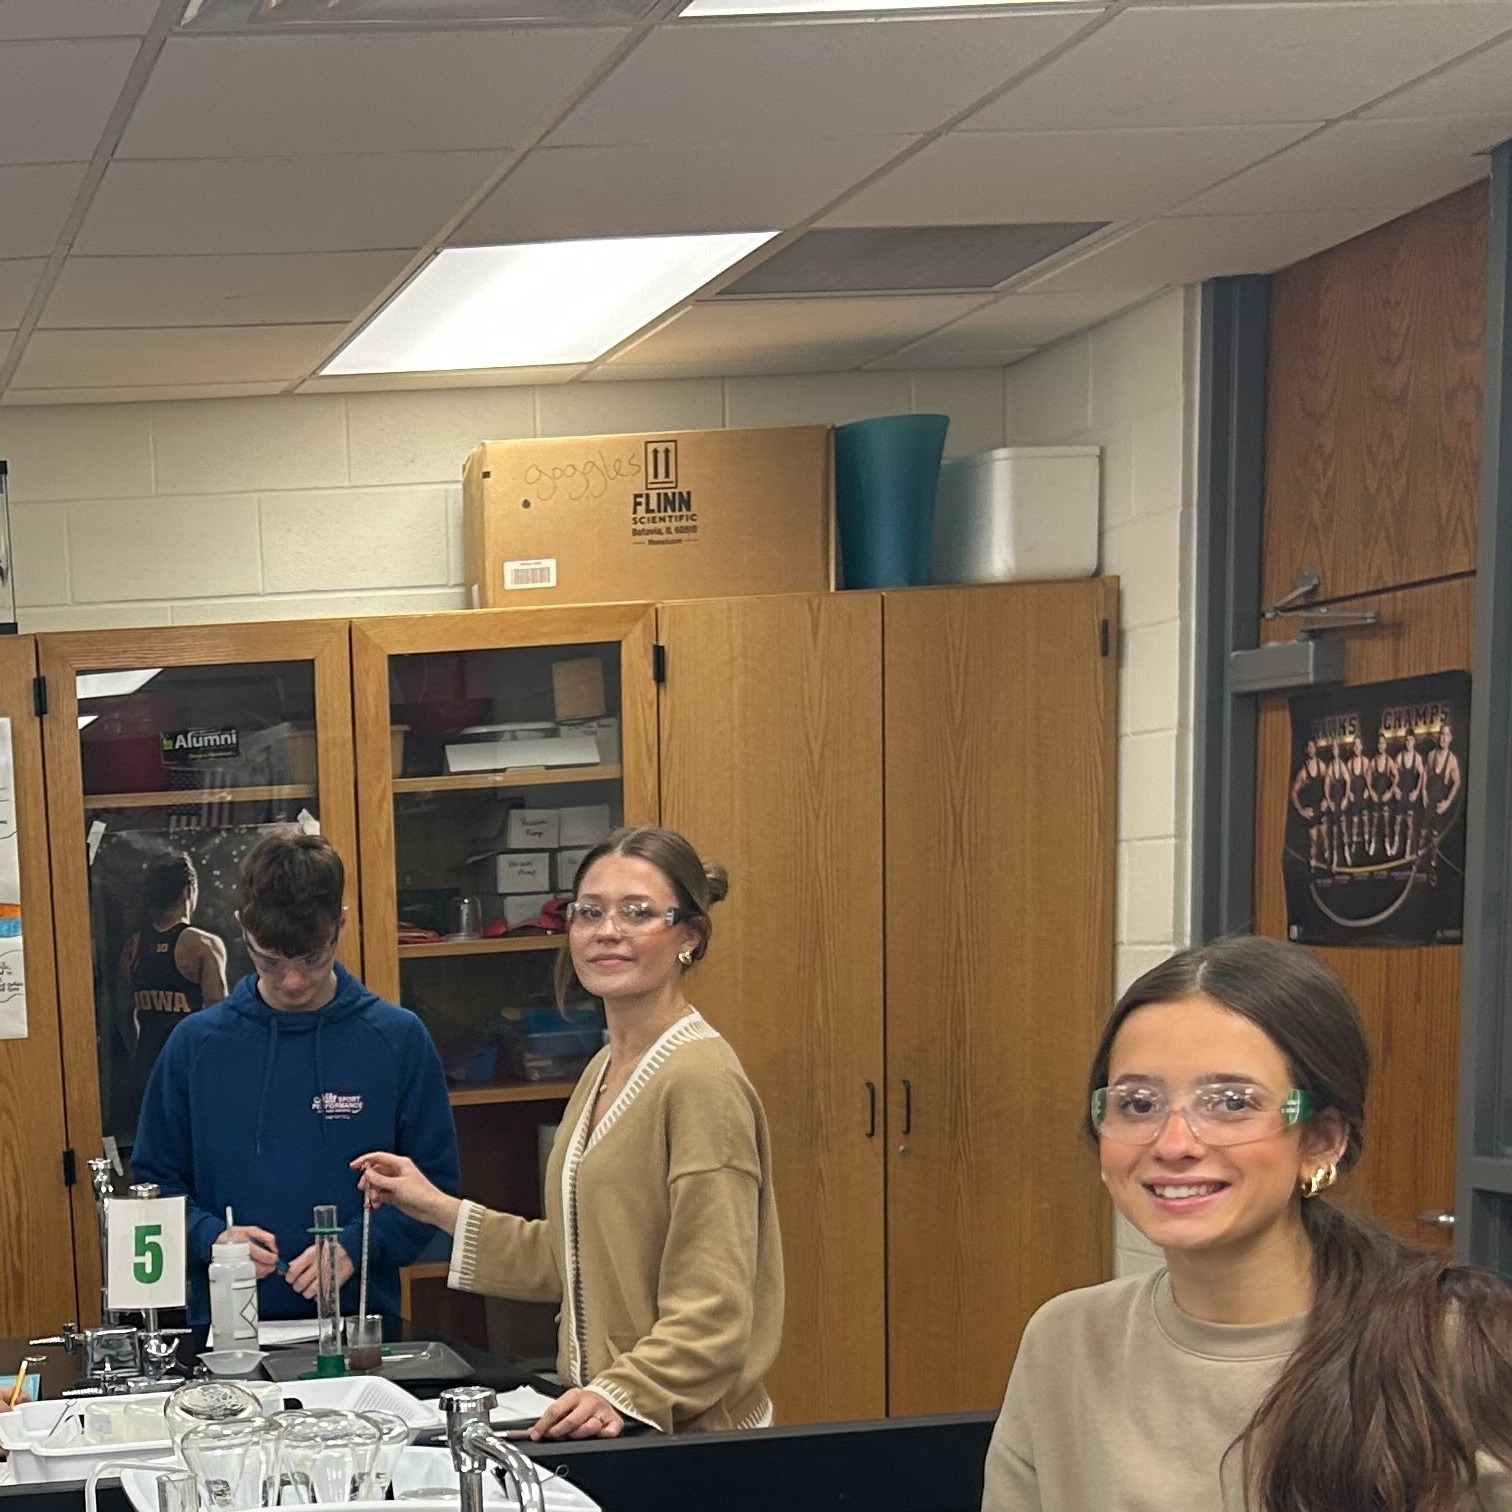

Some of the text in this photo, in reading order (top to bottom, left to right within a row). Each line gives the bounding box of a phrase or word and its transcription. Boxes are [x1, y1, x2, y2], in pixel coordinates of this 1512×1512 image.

[524, 450, 642, 501] goggles
[632, 491, 691, 515] FLINN
[632, 514, 697, 525] SCIENTIFIC
[1383, 702, 1451, 731] CHAMPS
[175, 730, 237, 749] Alumni
[133, 1224, 164, 1284] 5
